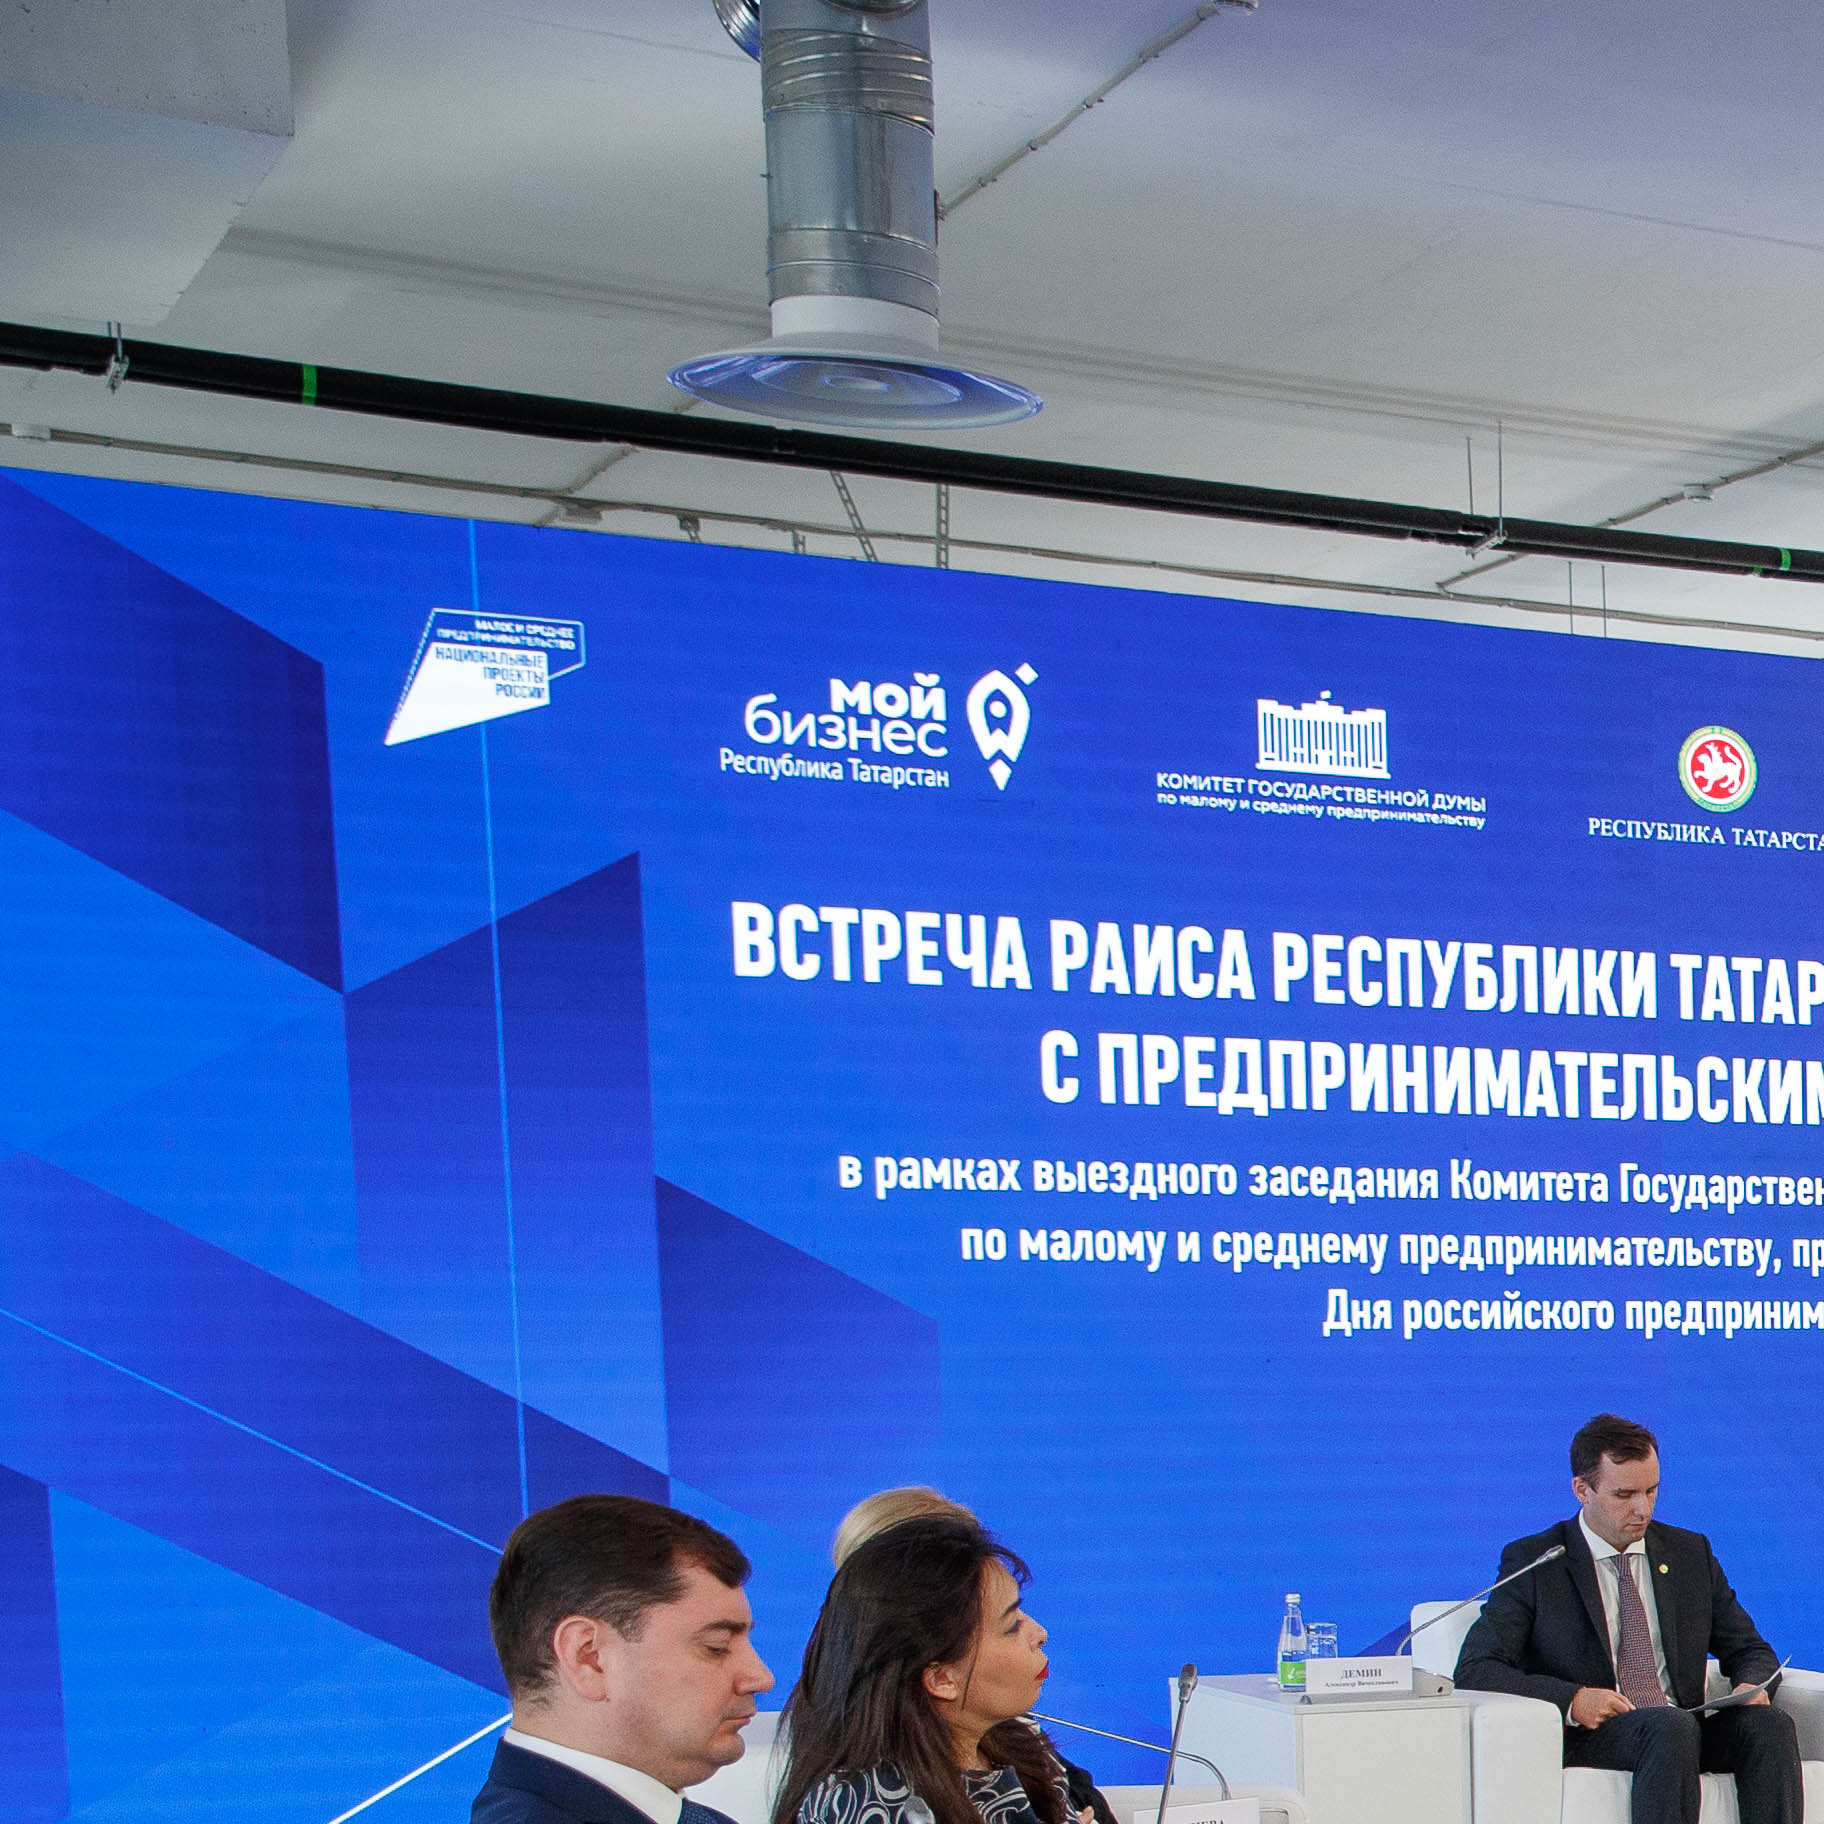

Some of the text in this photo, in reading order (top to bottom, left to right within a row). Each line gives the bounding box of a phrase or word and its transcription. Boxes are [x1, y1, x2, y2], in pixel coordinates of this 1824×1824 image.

[435, 646, 544, 668] НАЦИОНАЛЬНЫЕ
[484, 667, 544, 684] ПРОЕКТЫ
[496, 683, 545, 698] РОССИИ
[744, 693, 948, 758] бизнес
[719, 747, 950, 790] Республика Татарстан
[1156, 772, 1486, 813] КОМИТЕТ ГОСУДАРСТВЕННОЙ ДУМЫ
[1157, 792, 1486, 830] по малому и среднему предпринимательству
[1588, 817, 1726, 845] РЕСПУБЛИКА
[731, 901, 1031, 989] ВСТРЕЧА
[1050, 919, 1255, 1000] РАИСА
[1272, 931, 1657, 1018] РЕСПУБЛИКИ
[1040, 1029, 1079, 1103] С
[839, 1155, 862, 1188] в
[875, 1156, 1021, 1199] рамках
[1033, 1159, 1237, 1199] выездного
[1249, 1165, 1439, 1204] заседания
[1450, 1158, 1610, 1203] Комитета
[961, 1228, 1006, 1260] по
[1019, 1229, 1166, 1272] малому
[1177, 1231, 1200, 1262] и
[1213, 1231, 1388, 1274] среднему
[1399, 1232, 1783, 1278] предпринимательству,
[1322, 1288, 1392, 1337] Дня
[1403, 1291, 1614, 1340] российского
[1341, 1668, 1382, 1679] ДЕМИН
